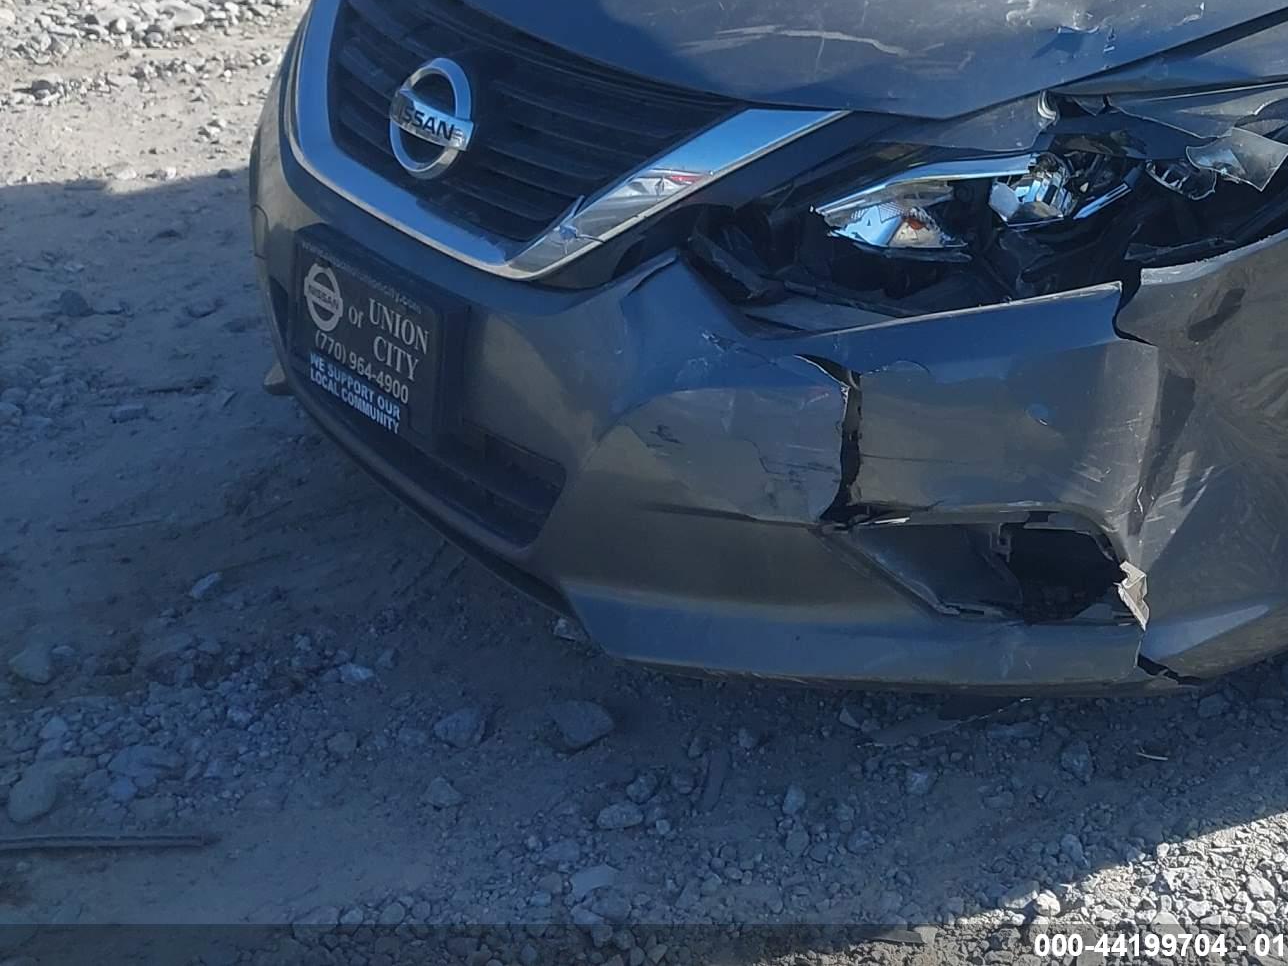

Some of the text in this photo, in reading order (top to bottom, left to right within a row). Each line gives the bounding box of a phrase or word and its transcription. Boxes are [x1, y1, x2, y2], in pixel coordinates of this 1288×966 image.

[368, 297, 430, 355] UNION
[373, 336, 419, 382] CITY
[310, 353, 401, 421] WE SUPPORT OUR
[315, 329, 409, 404] (770) 964-4900
[310, 367, 400, 435] LOCAL COMMUNITY
